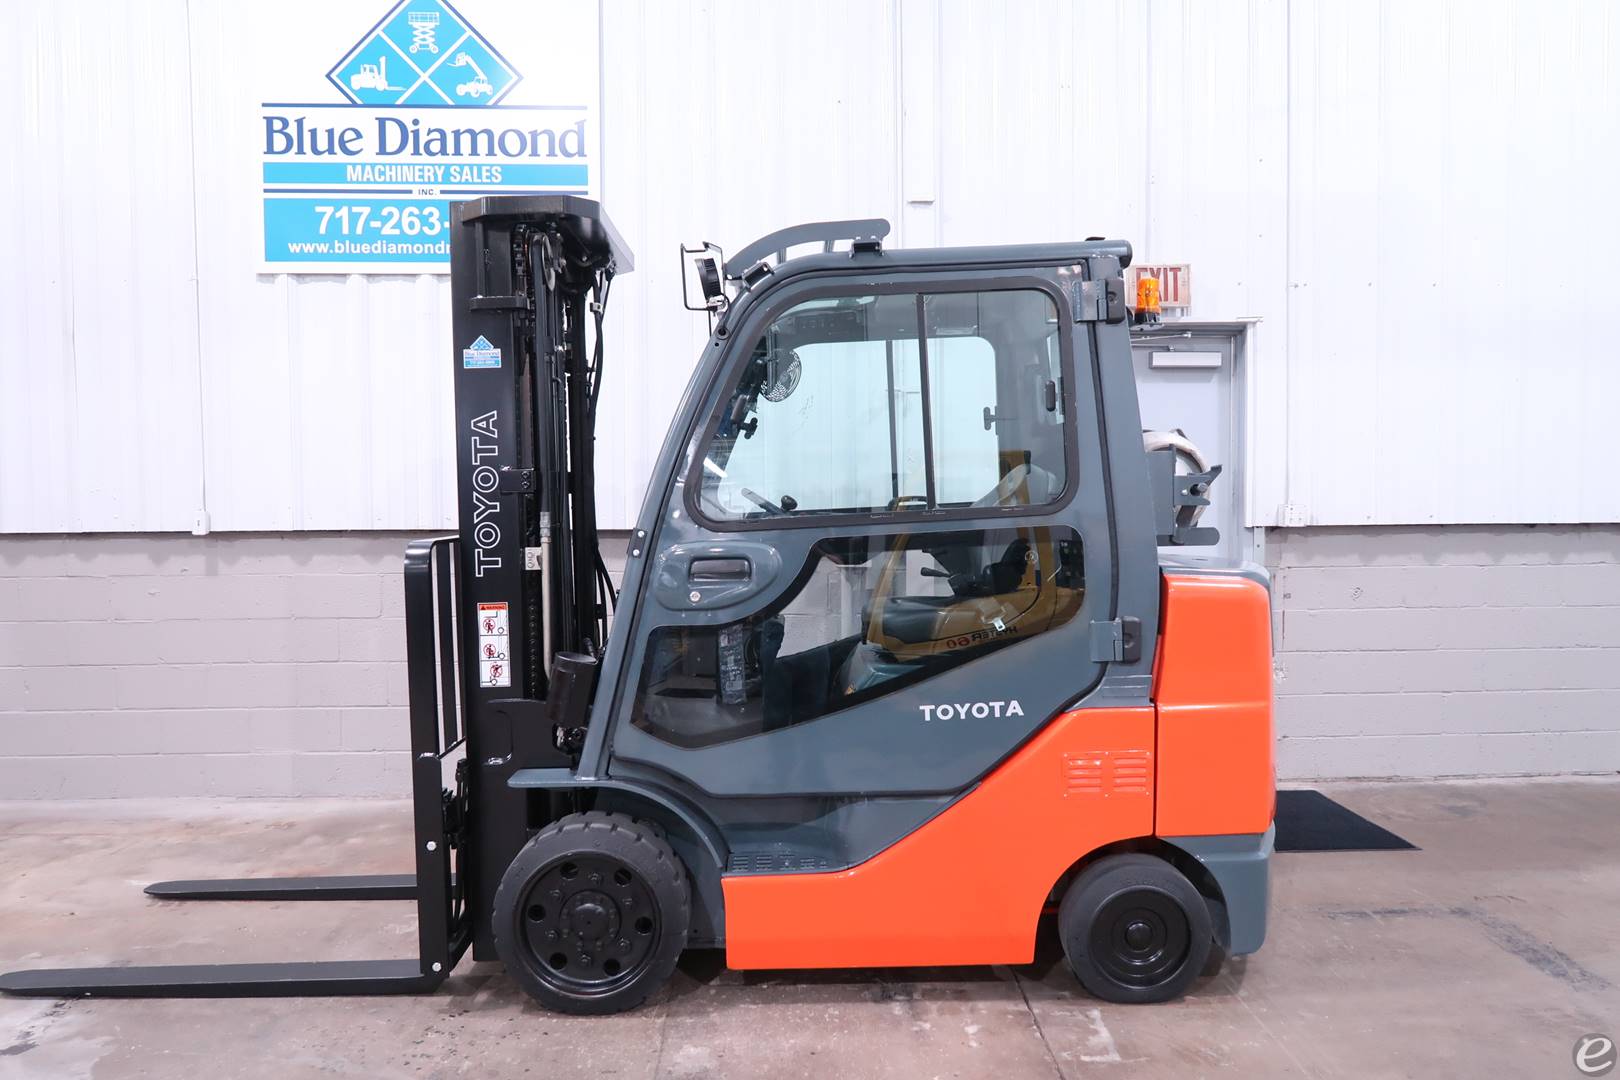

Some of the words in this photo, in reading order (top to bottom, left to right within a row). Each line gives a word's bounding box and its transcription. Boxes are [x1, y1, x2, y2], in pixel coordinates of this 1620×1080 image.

[262, 115, 364, 156] Blue
[374, 116, 588, 159] Diamond
[346, 164, 445, 184] MACHINERY
[449, 165, 502, 184] SALES
[417, 188, 438, 196] INC.
[470, 409, 502, 578] TOYOTA
[919, 699, 1025, 722] TOYOTA
